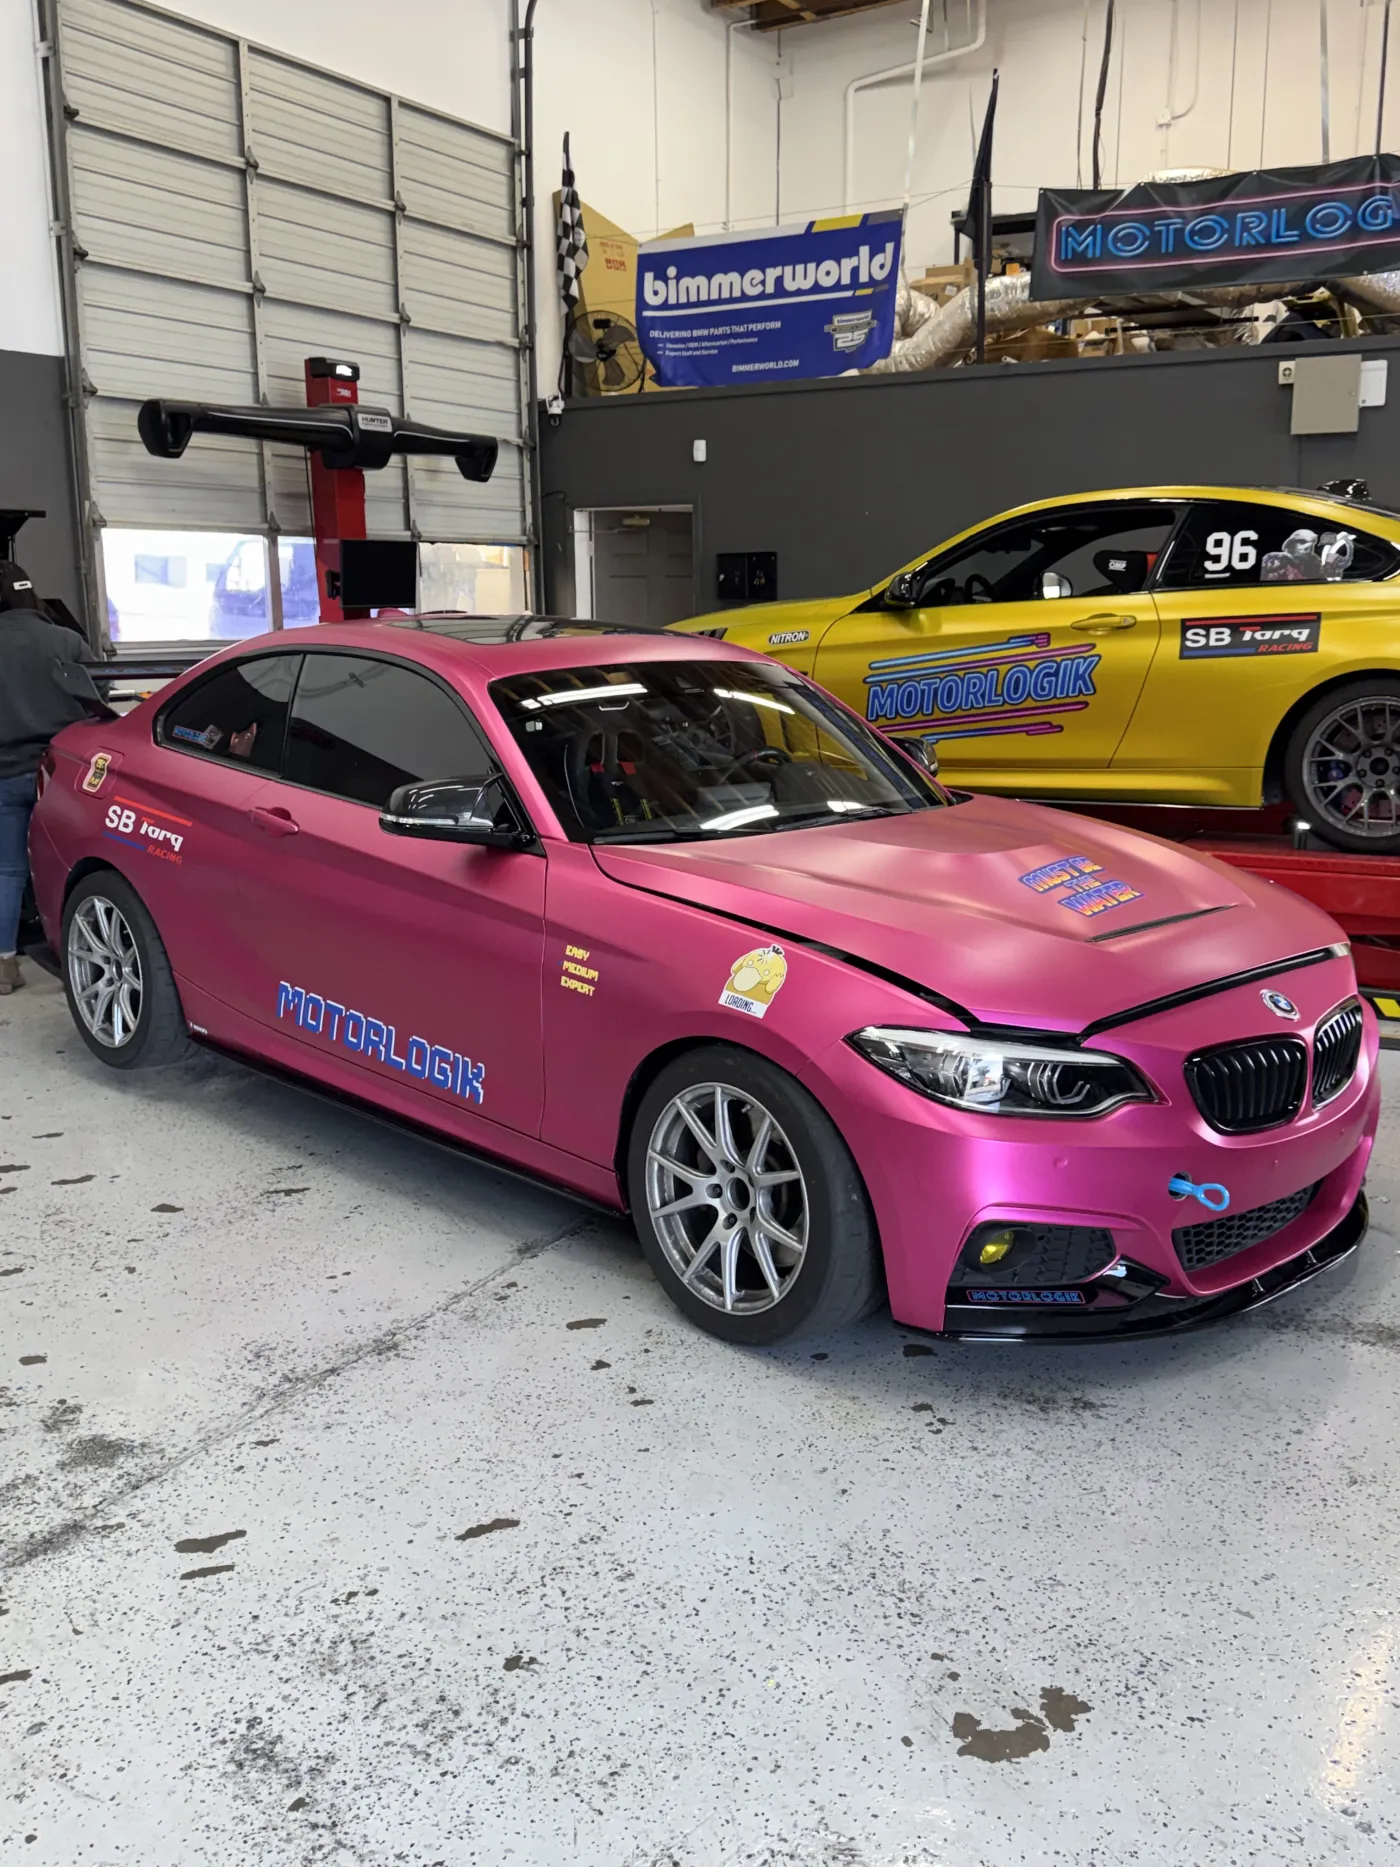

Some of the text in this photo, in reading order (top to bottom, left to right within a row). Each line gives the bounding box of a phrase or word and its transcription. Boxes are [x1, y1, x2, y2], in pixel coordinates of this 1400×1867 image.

[643, 242, 895, 306] bimmerworld
[649, 320, 782, 339] DELIVERING BMW PARTS THAT PERFORM
[834, 329, 866, 348] 25
[731, 359, 800, 373] BIMMERWORLD.COM
[361, 415, 389, 425] HUNTER
[1204, 530, 1259, 572] 96
[1185, 627, 1232, 648] SB
[1257, 642, 1314, 653] RACING
[867, 655, 1100, 721] MOTORLOGIK
[105, 805, 136, 833] SB
[147, 845, 184, 866] RACING
[1021, 856, 1103, 893] MUST BE
[1063, 874, 1102, 893] THE
[1060, 880, 1142, 916] WATER
[565, 944, 590, 961] EASY
[562, 960, 599, 982] MEDIUM
[560, 975, 596, 997] EXPERT
[277, 980, 486, 1105] MOTORLOGIK
[971, 1291, 1082, 1302] MOTORLOGIK
